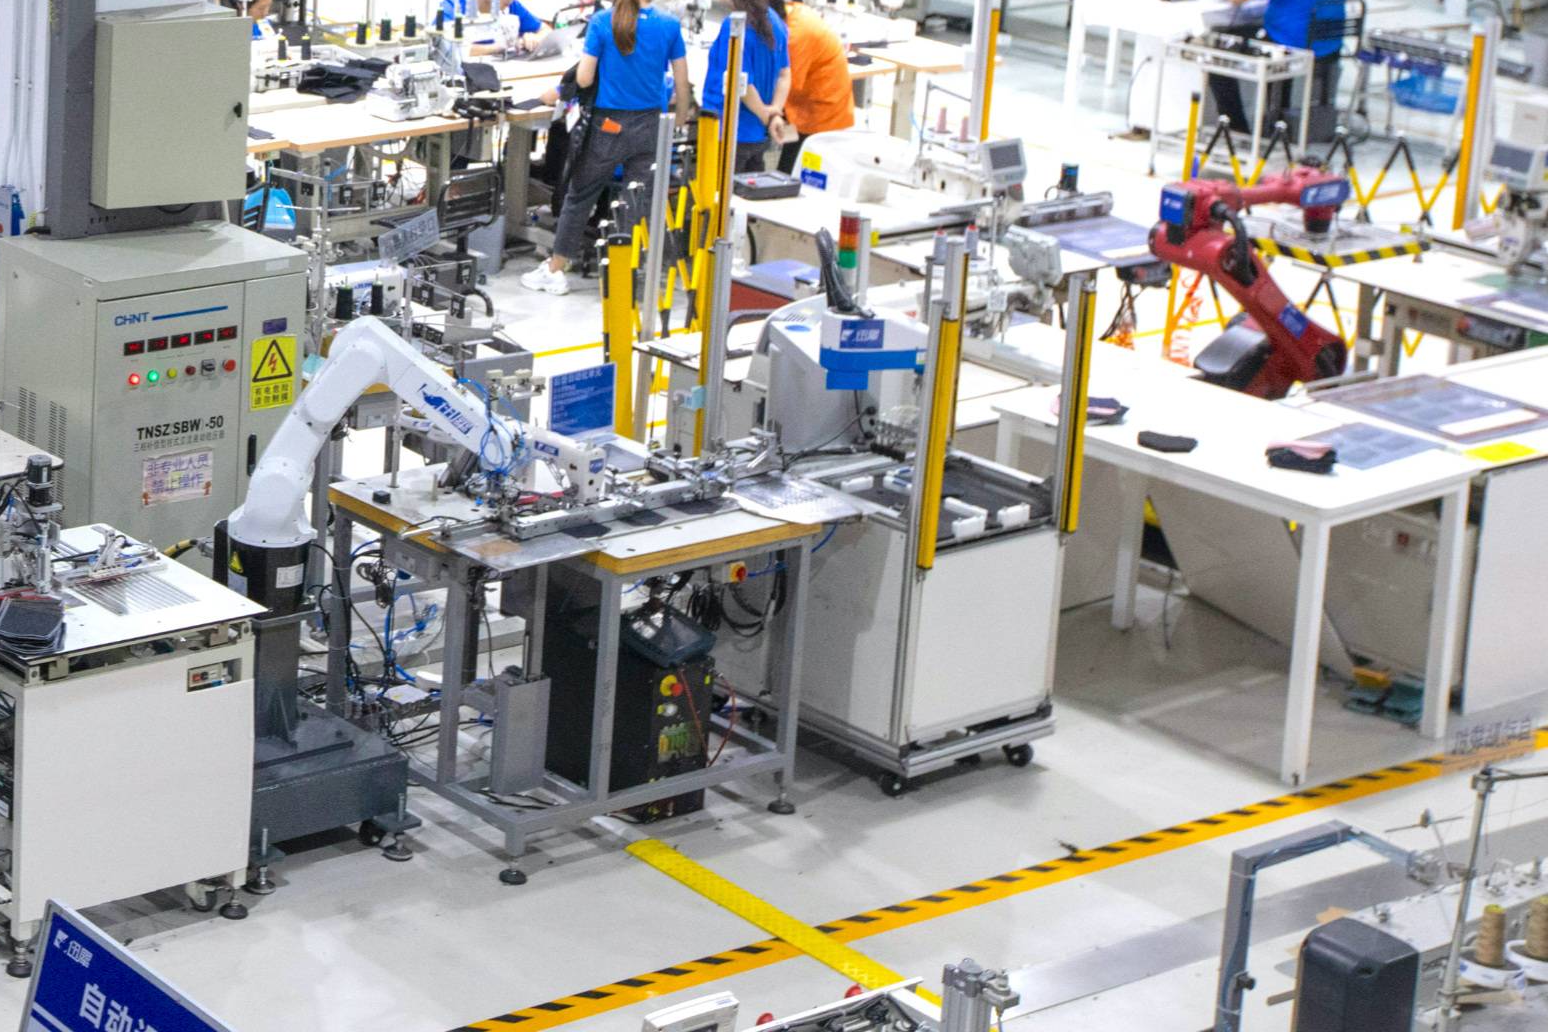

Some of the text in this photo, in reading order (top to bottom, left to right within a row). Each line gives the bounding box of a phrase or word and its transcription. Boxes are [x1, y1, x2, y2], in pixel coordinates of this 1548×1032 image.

[147, 453, 210, 476] 非专业人员
[152, 471, 204, 494] 禁止操作
